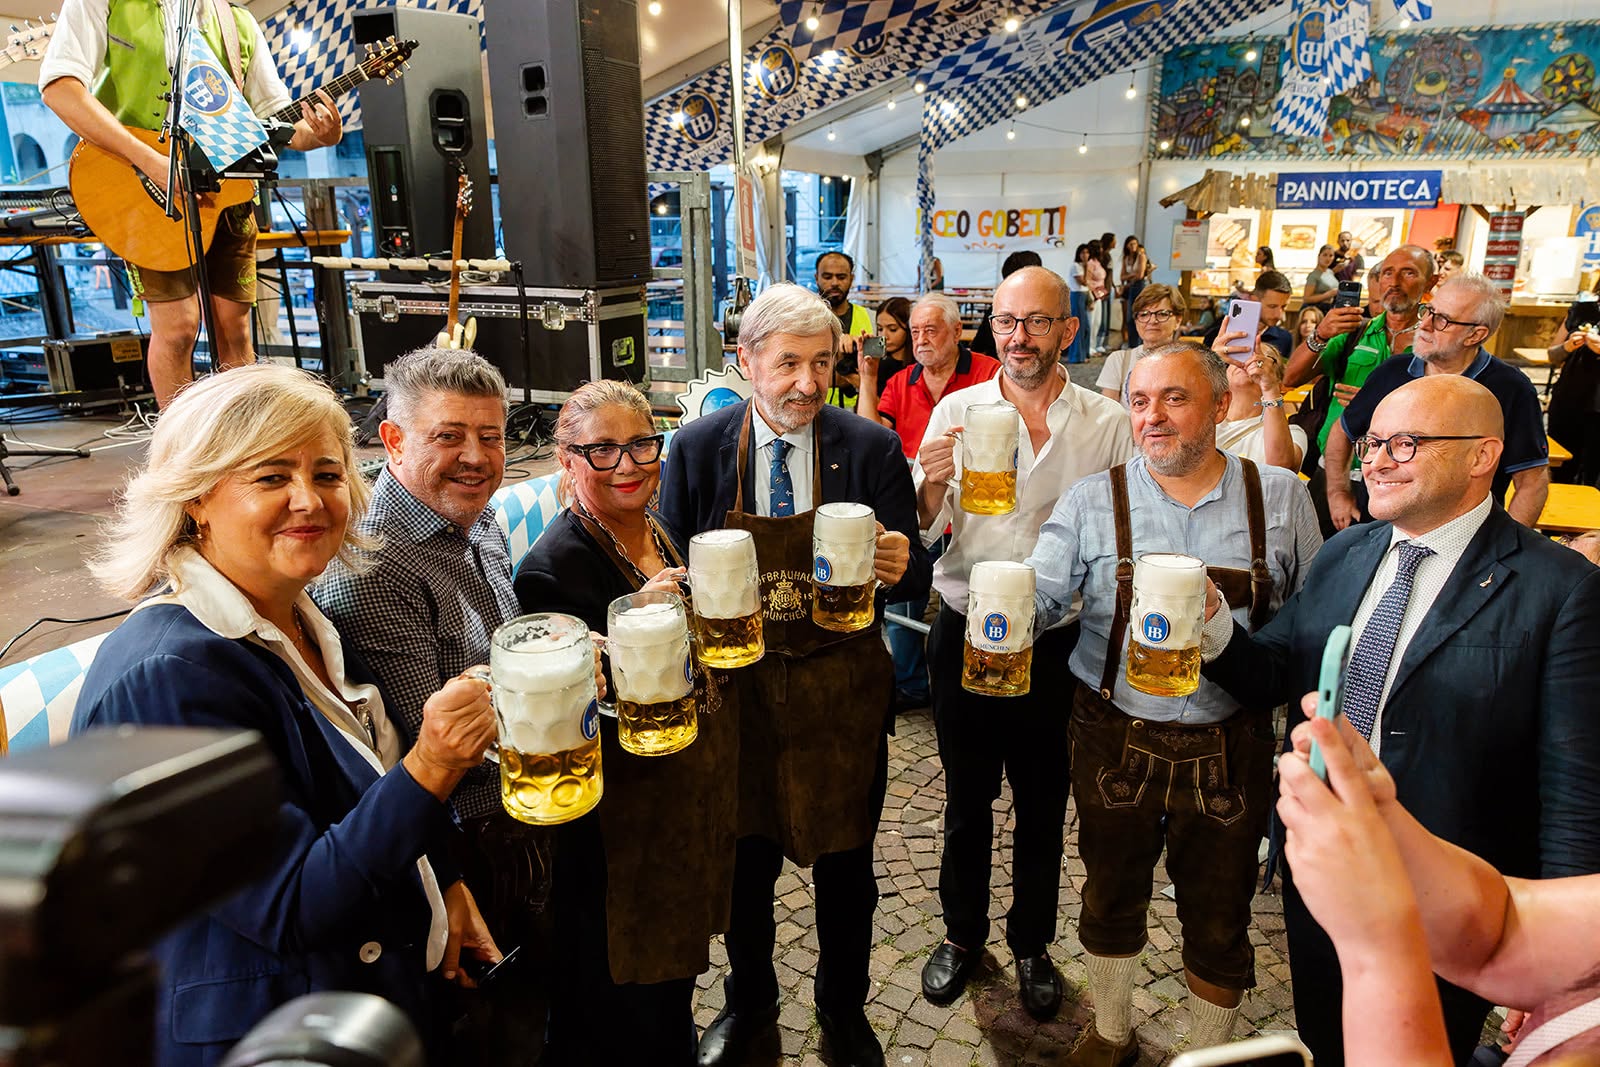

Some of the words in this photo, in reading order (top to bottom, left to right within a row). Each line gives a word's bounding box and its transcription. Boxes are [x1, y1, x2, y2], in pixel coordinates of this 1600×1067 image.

[768, 67, 792, 92] HB
[185, 79, 213, 107] HB
[690, 113, 713, 138] HB
[1282, 178, 1431, 201] PANINOTECA
[977, 205, 1067, 238] GOBETTI
[817, 567, 827, 579] HB
[989, 626, 1003, 639] HB
[1147, 626, 1163, 639] HB
